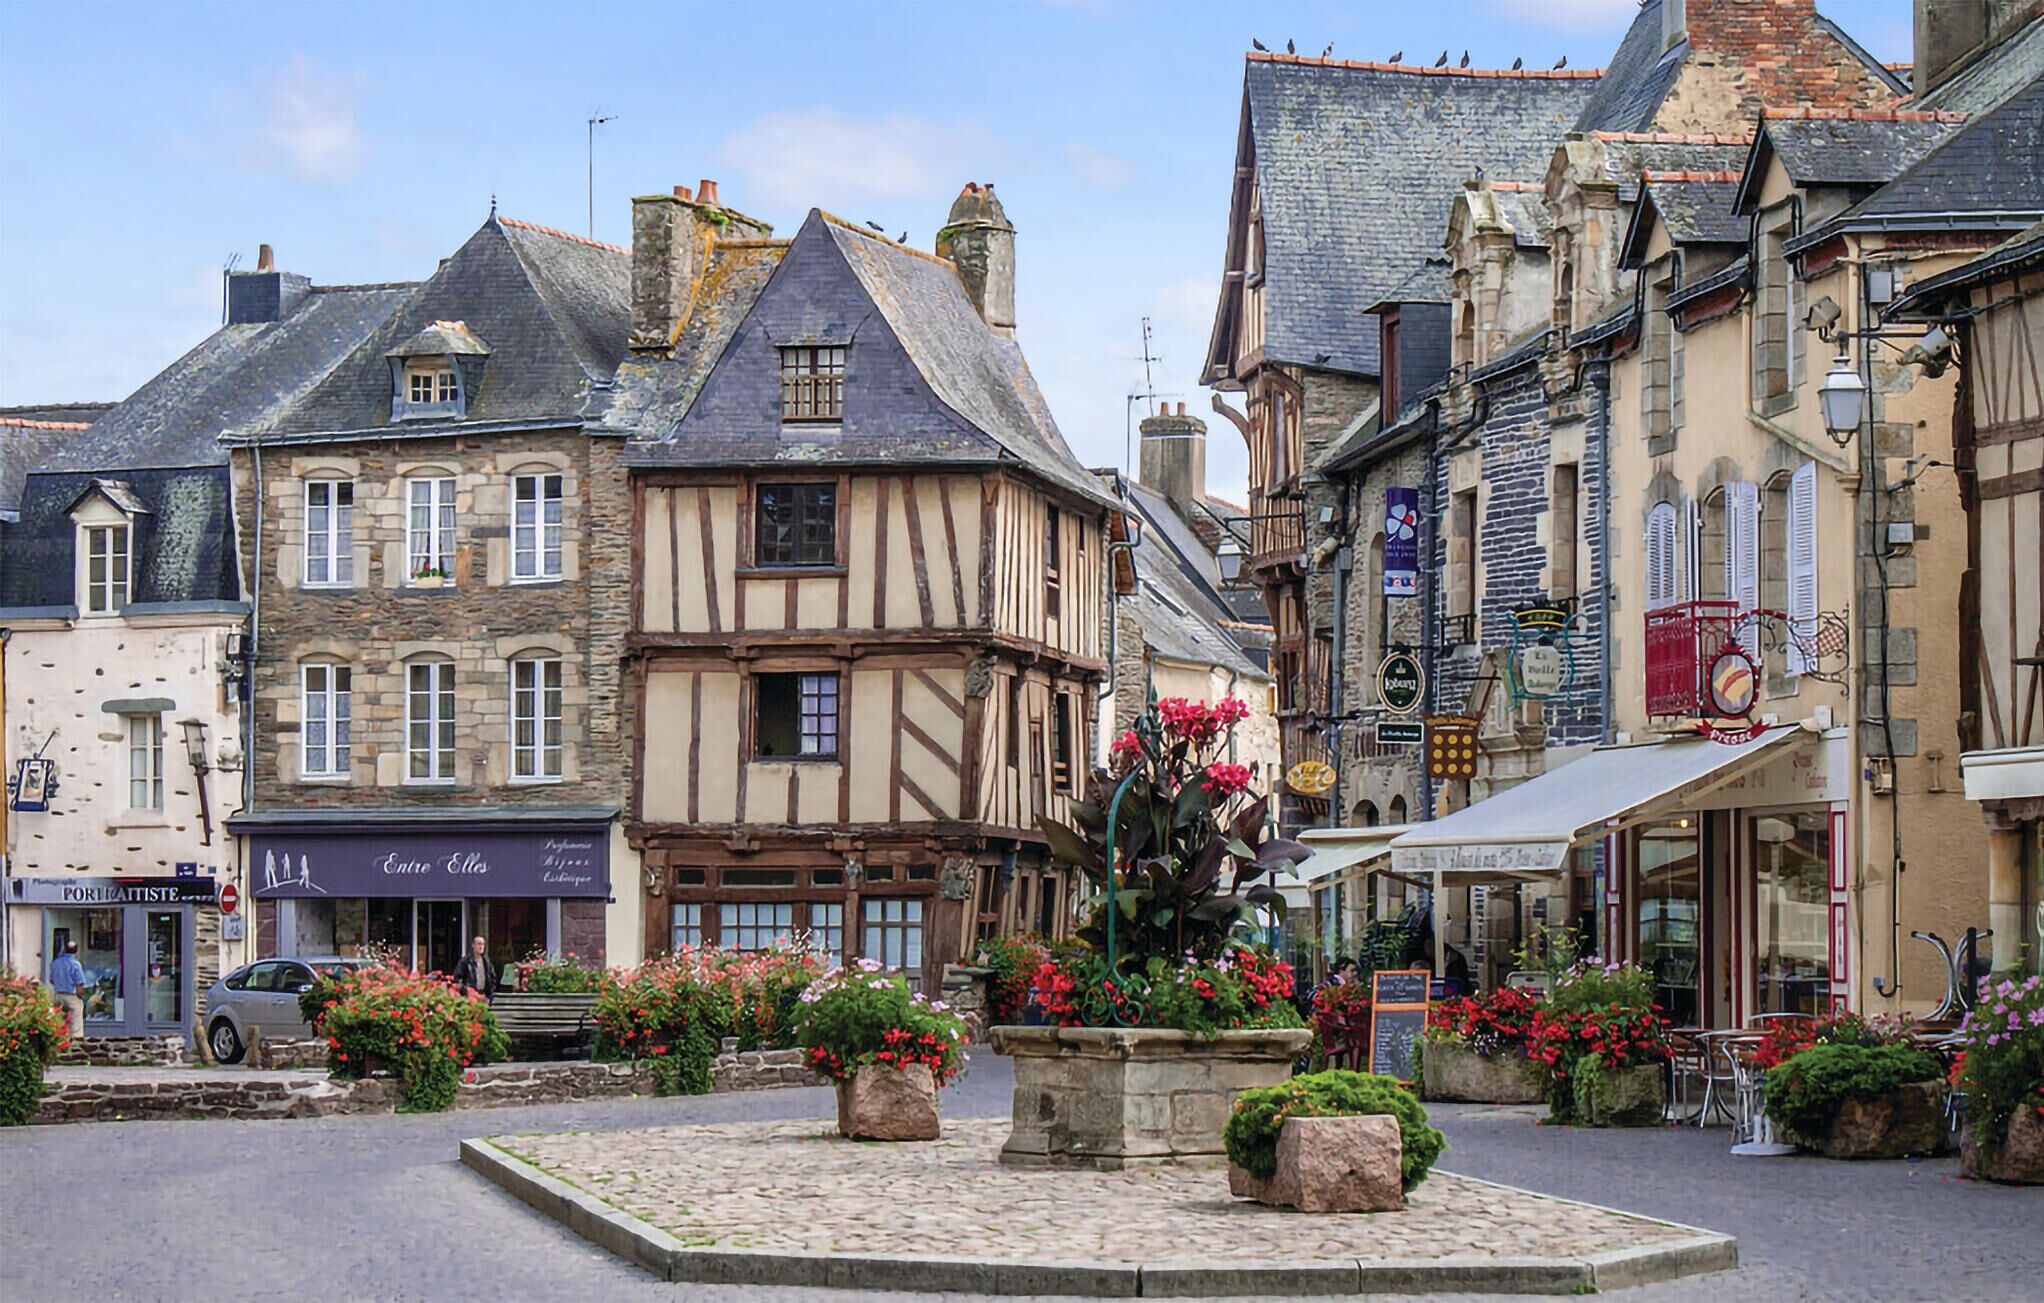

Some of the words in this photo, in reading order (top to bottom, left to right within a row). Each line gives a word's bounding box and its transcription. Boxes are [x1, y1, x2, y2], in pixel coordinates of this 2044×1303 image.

[380, 852, 432, 874] Entre
[443, 852, 487, 874] Elles
[62, 886, 179, 901] PORTRAITISTE
